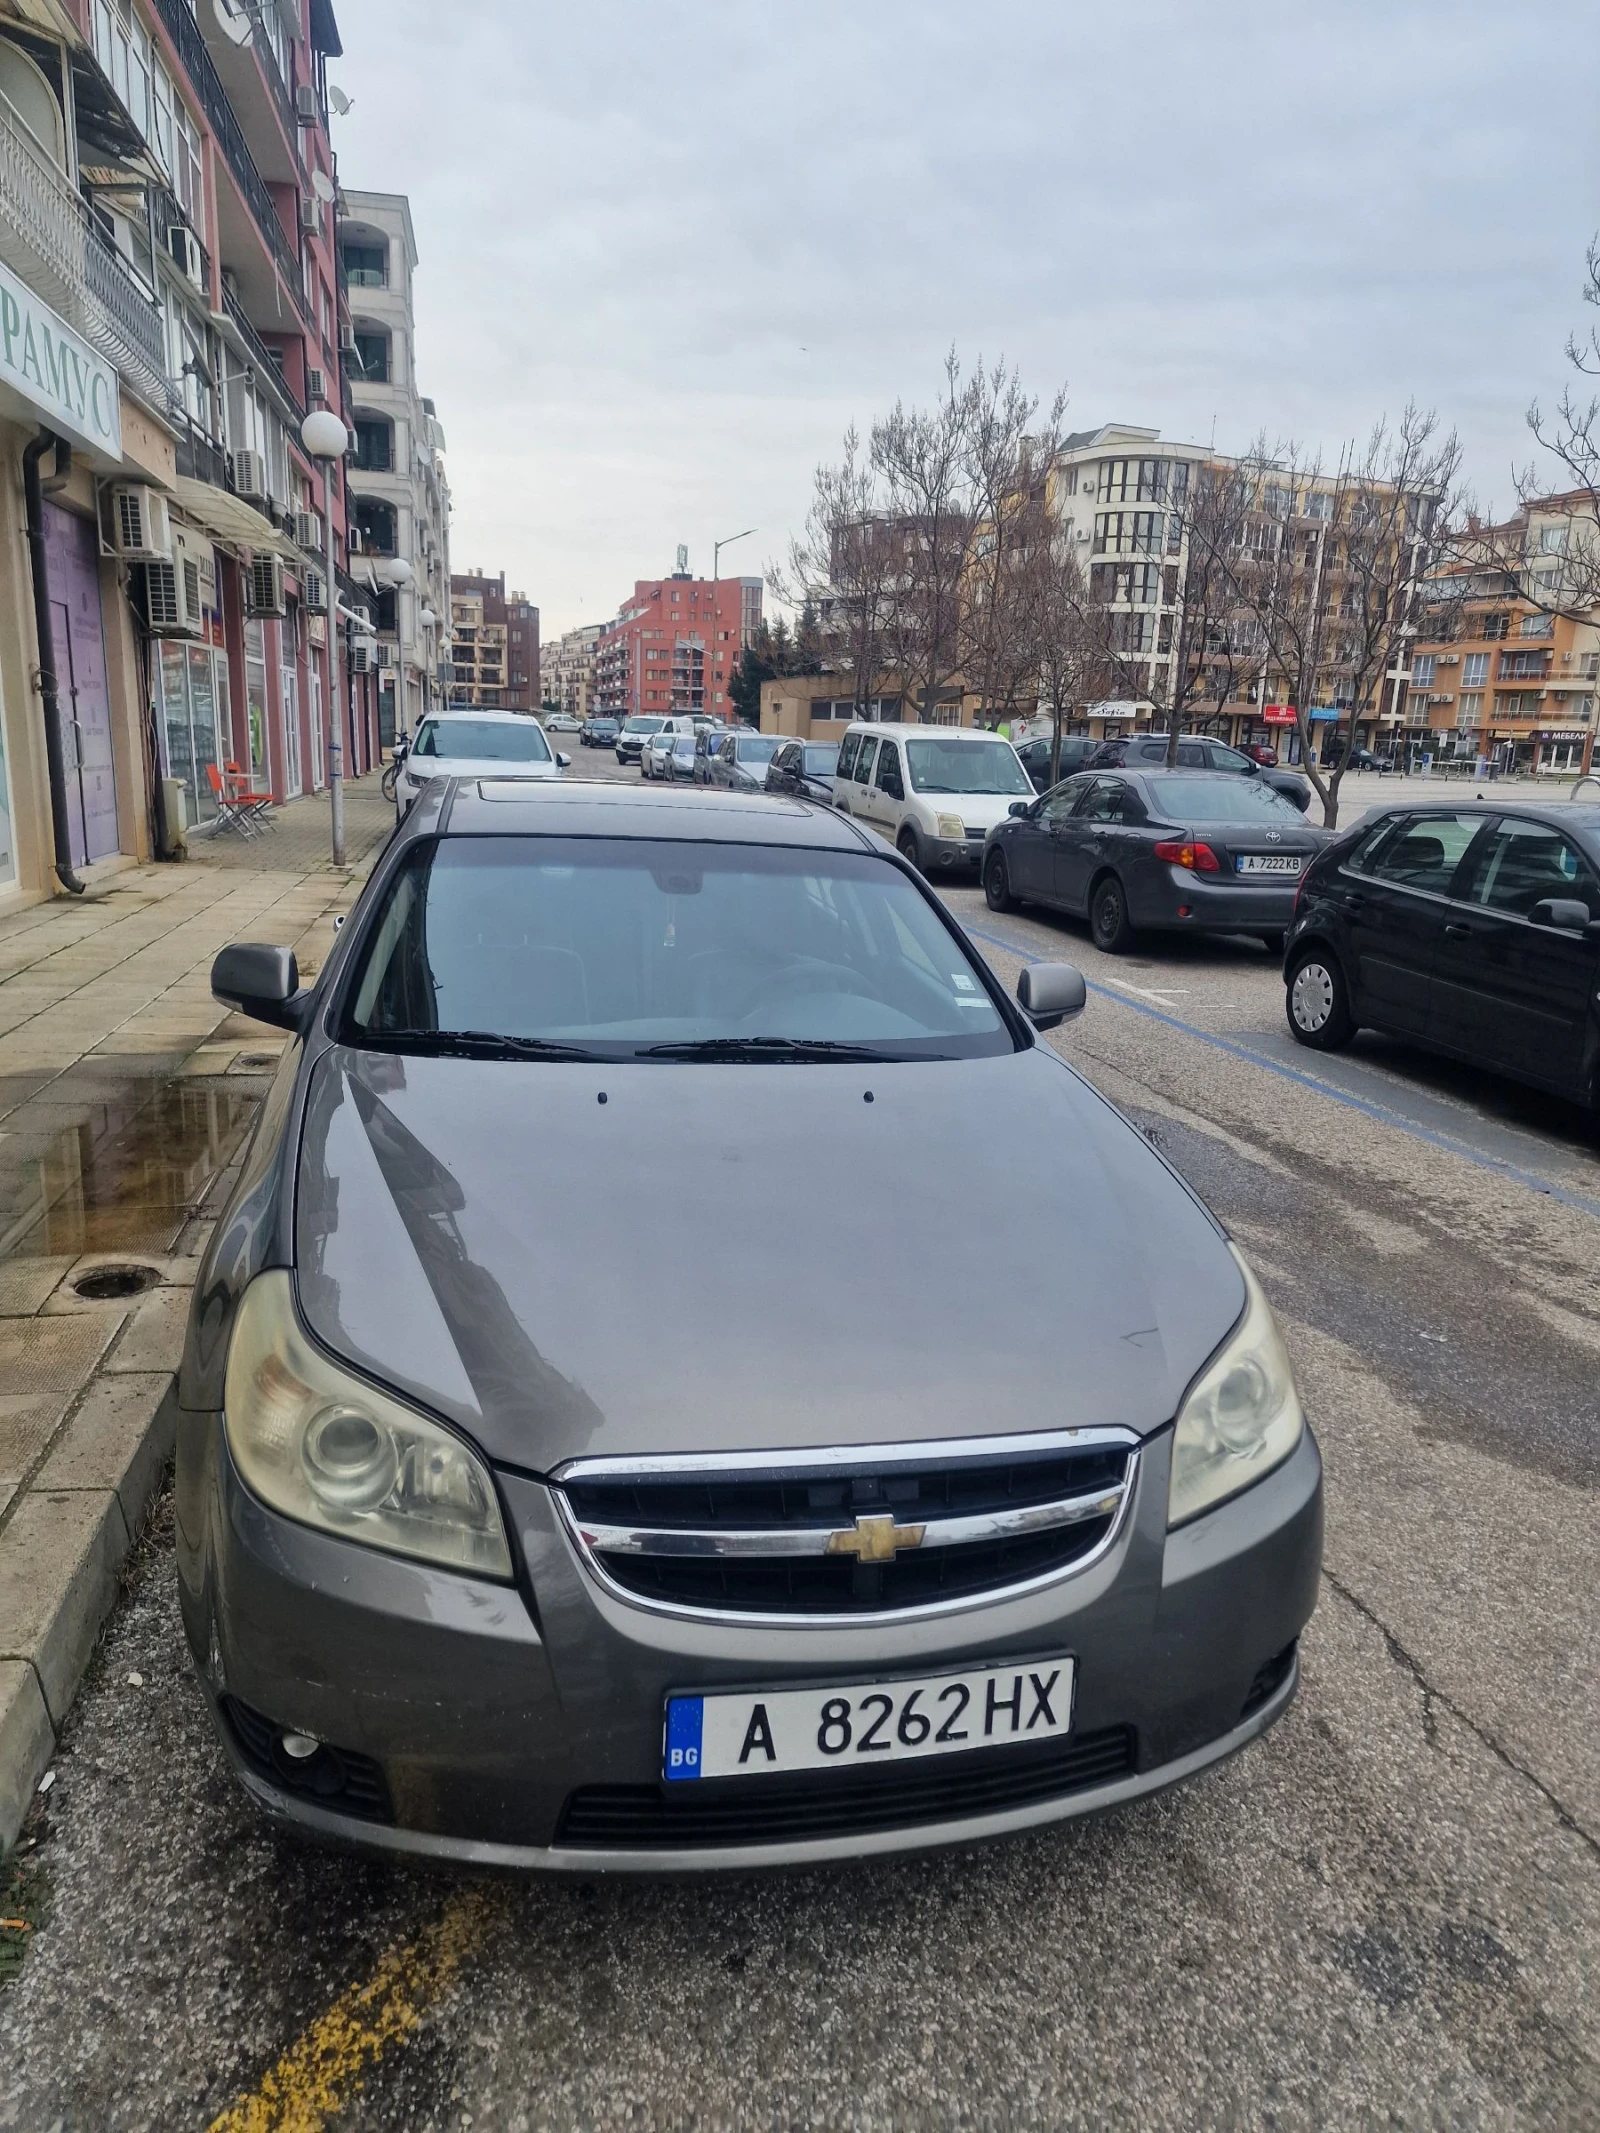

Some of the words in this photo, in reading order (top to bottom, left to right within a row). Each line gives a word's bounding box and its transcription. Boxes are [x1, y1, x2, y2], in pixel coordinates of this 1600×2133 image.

[0, 285, 111, 437] РАМУС
[1552, 732, 1586, 740] МЕБЕЛИ
[738, 1703, 777, 1763] A
[671, 1748, 698, 1766] BG
